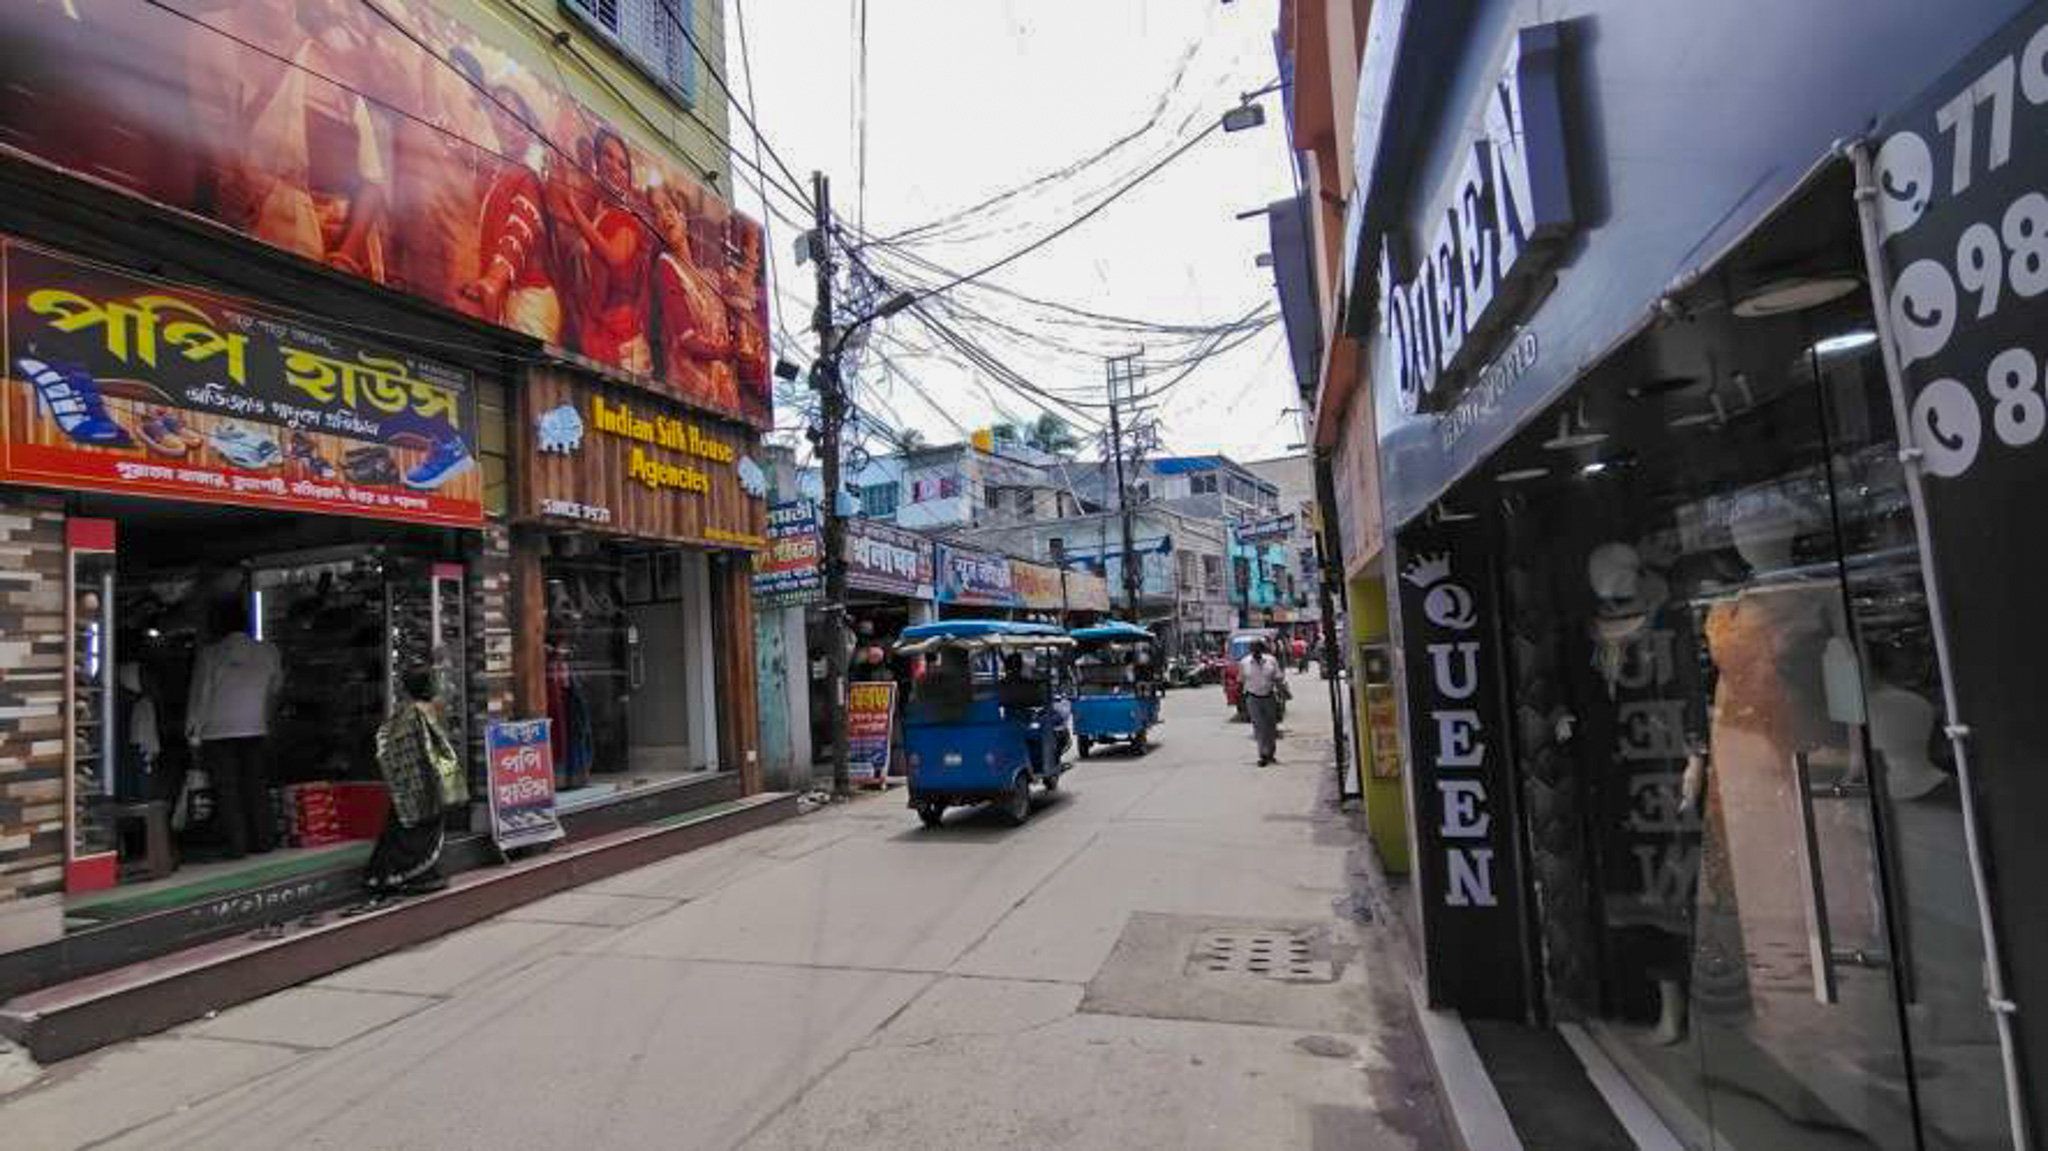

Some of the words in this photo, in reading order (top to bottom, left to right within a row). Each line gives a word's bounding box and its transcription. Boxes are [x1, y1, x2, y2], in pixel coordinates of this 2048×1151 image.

[1389, 30, 1536, 415] QUEEN
[28, 289, 248, 386] পপি
[592, 394, 653, 442] Indian
[657, 415, 687, 452] Silk
[689, 425, 733, 464] House
[1987, 348, 2048, 446] 8
[628, 446, 709, 494] Agencies
[1423, 582, 1498, 907] QUEEN
